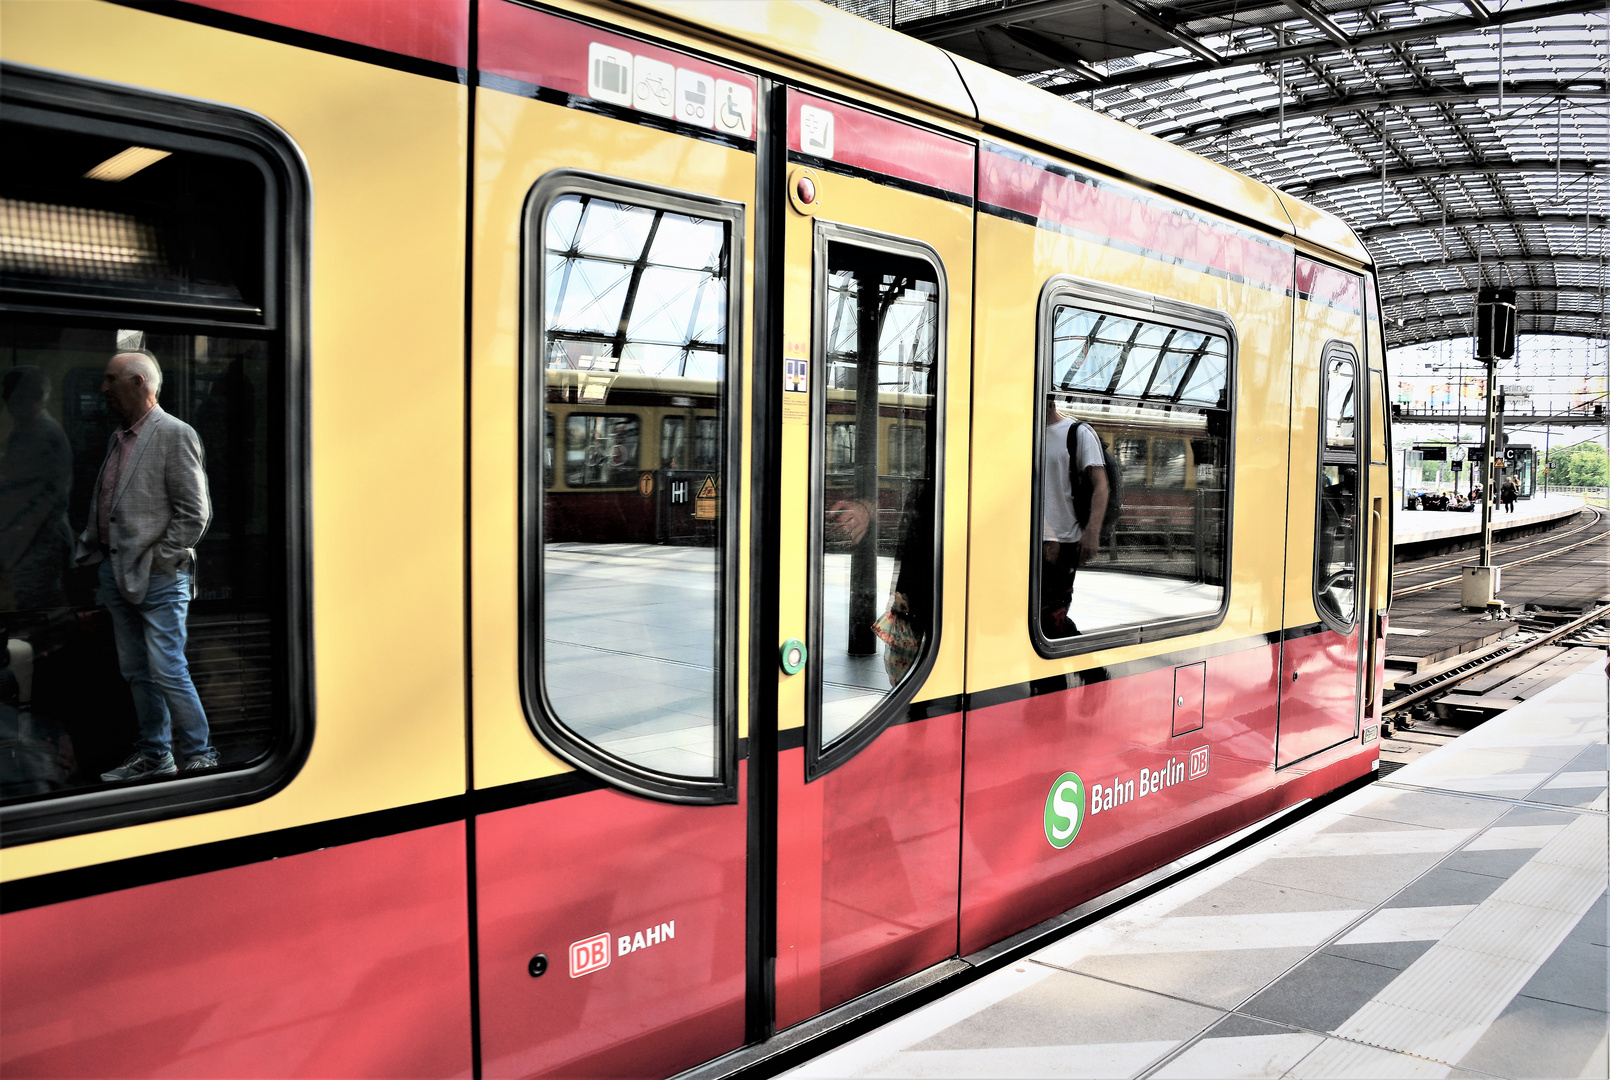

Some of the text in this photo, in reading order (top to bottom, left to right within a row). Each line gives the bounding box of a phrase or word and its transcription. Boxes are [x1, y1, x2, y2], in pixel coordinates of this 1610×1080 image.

[1506, 449, 1514, 459] C
[1052, 749, 1207, 840] S Bahn Berlin DB
[574, 920, 675, 972] DB BAHN
